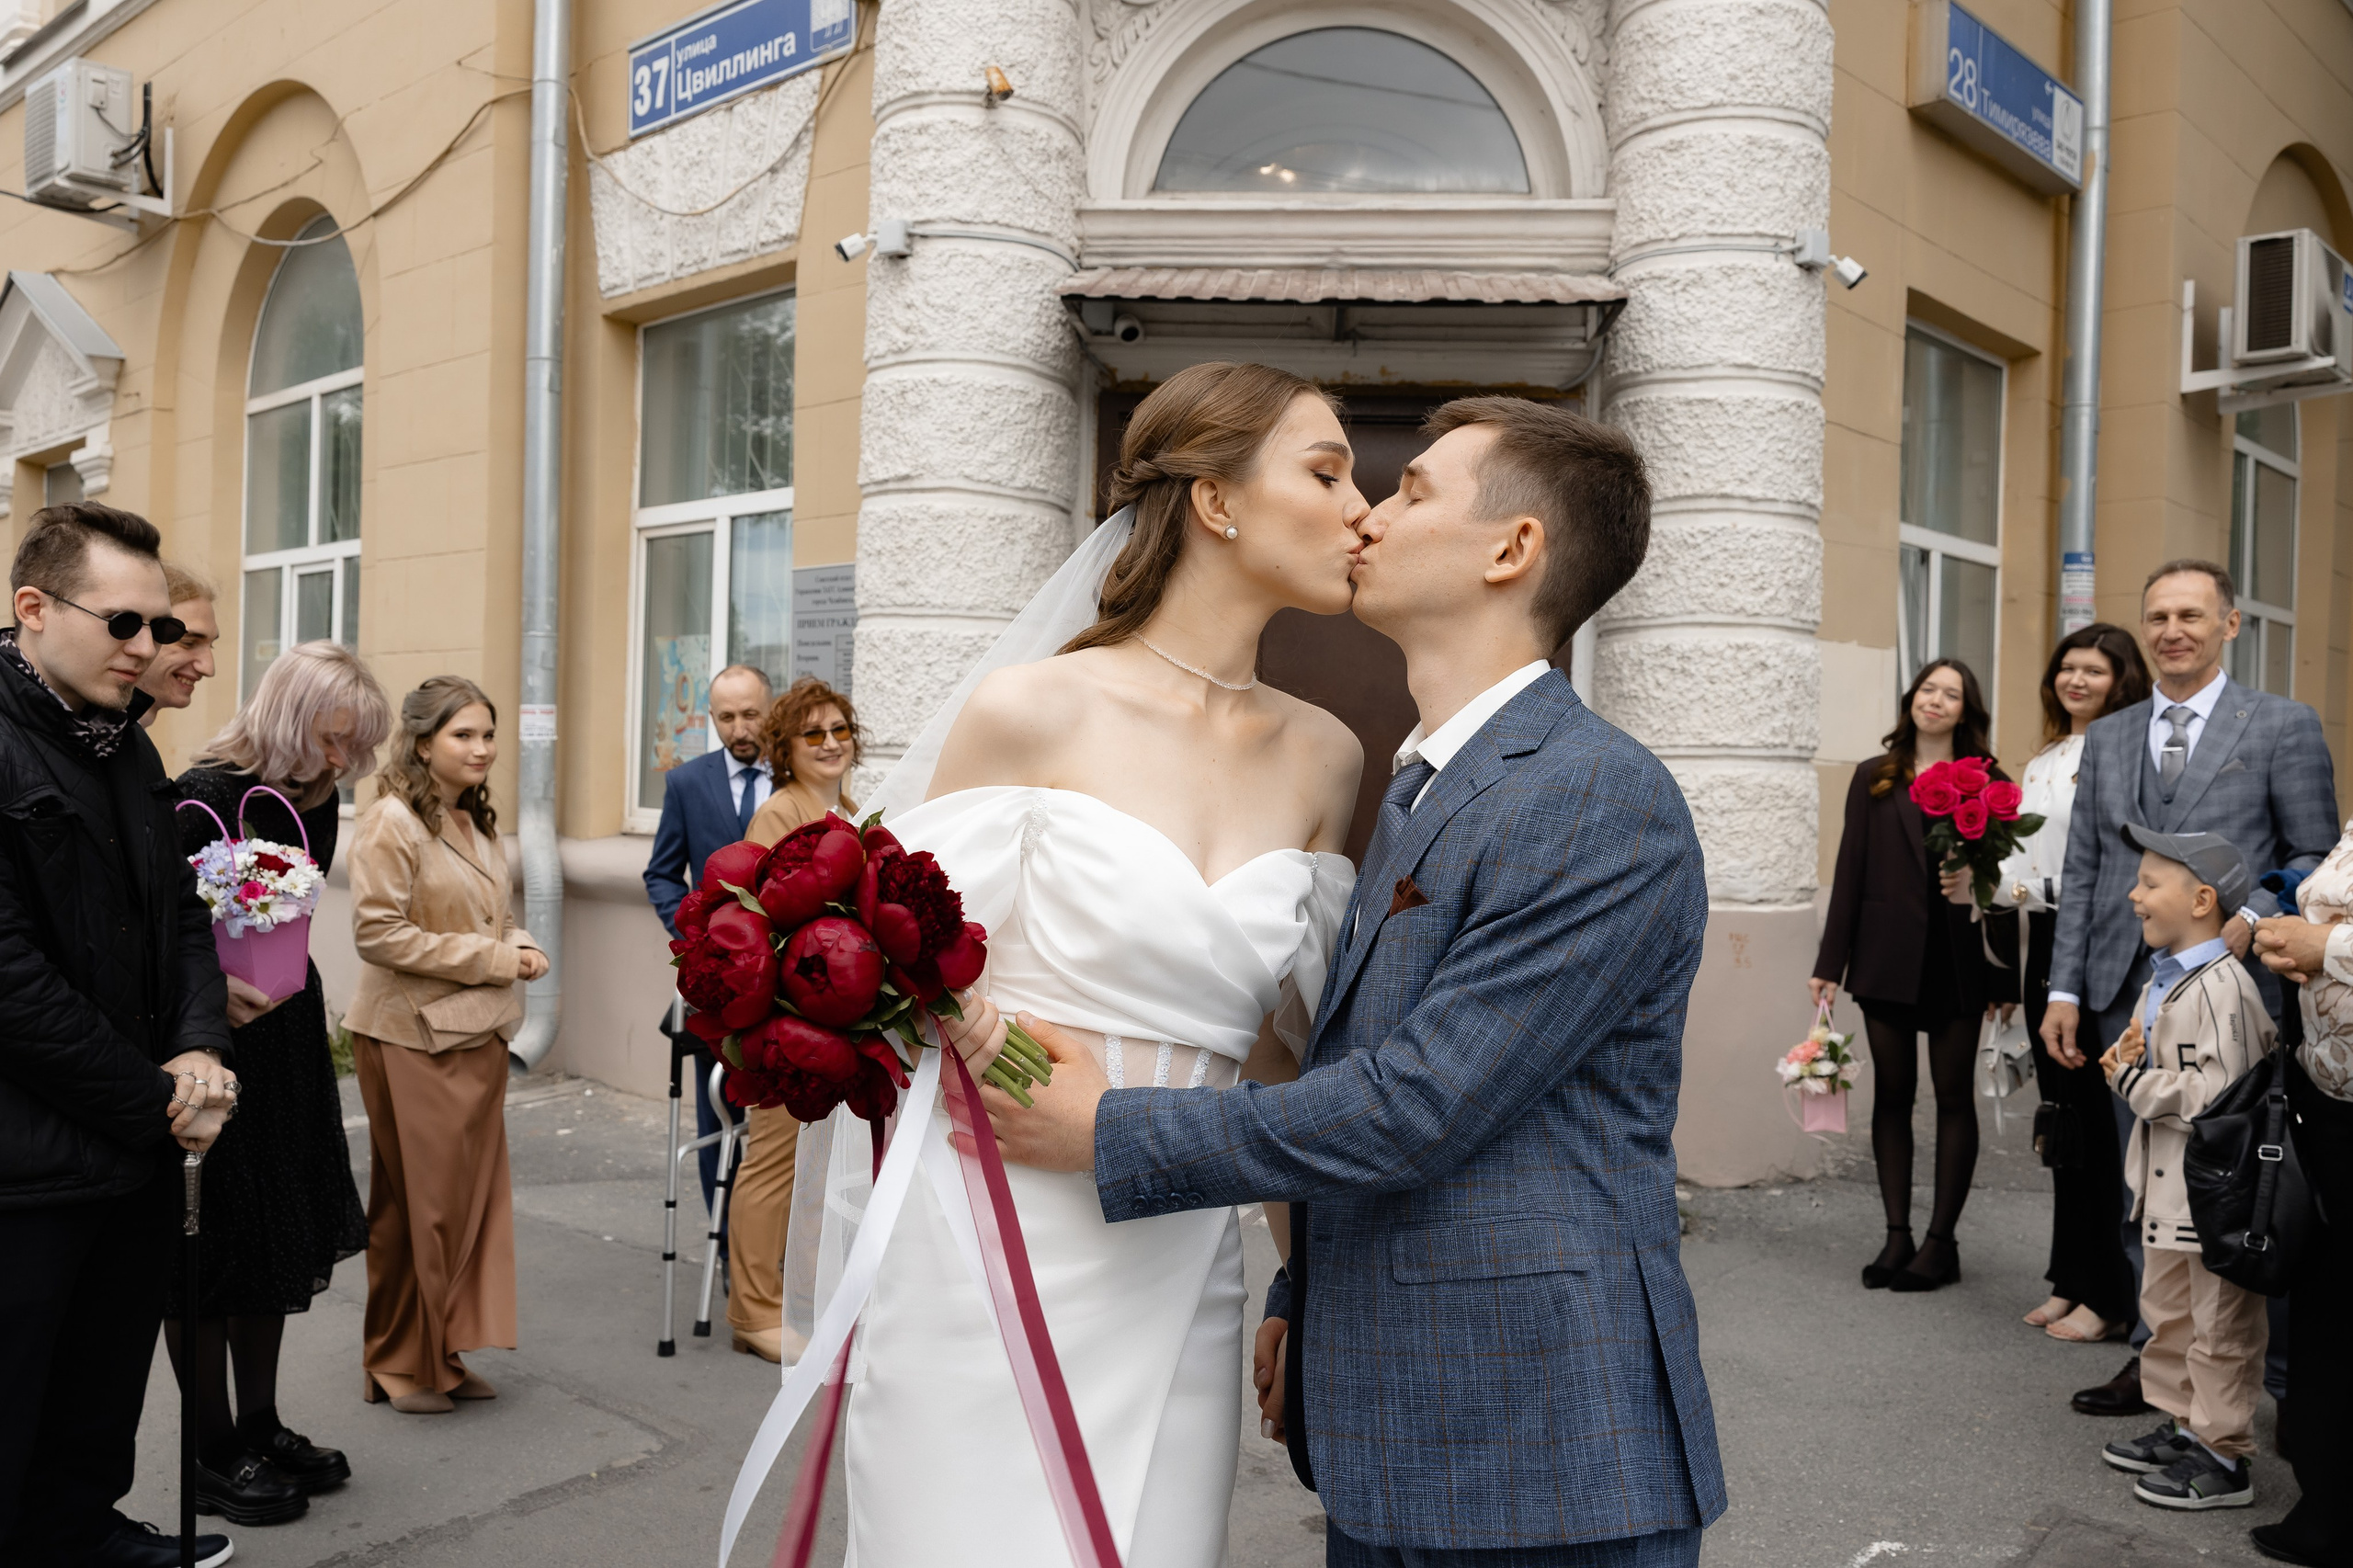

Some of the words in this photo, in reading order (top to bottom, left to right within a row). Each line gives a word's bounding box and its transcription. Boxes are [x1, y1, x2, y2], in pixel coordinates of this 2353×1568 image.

[676, 33, 718, 69] улица
[676, 30, 797, 103] Цвиллинга
[1948, 46, 1978, 109] 28
[633, 55, 670, 118] 37
[1981, 87, 2052, 160] Тимирязева
[825, 617, 858, 628] ГРАЖД
